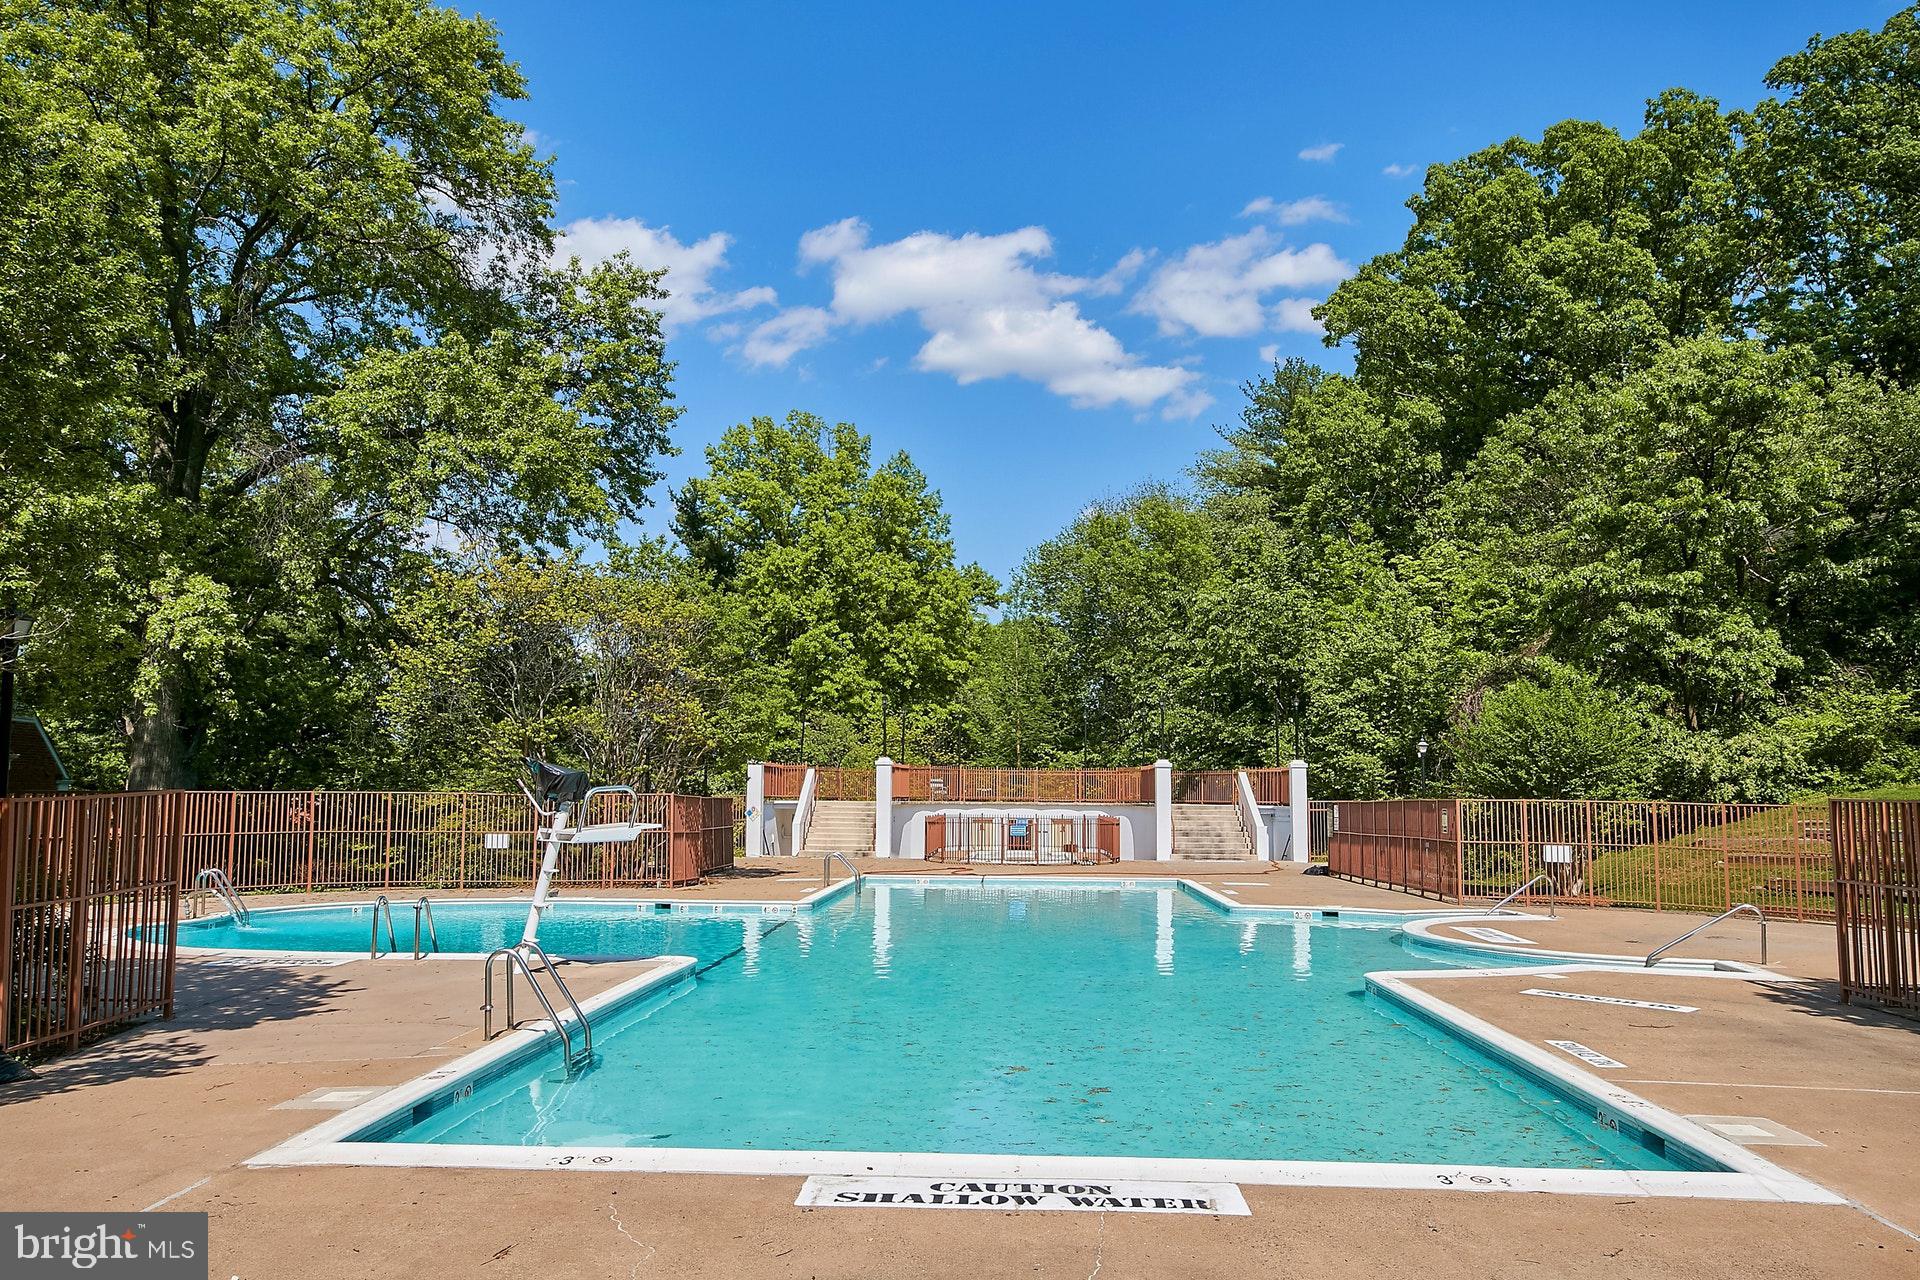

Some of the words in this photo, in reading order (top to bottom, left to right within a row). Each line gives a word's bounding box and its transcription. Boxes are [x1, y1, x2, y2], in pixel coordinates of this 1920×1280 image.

[929, 1182, 1113, 1195] CAUTION
[833, 1191, 1048, 1206] SHALLOW
[1065, 1195, 1217, 1211] WATER
